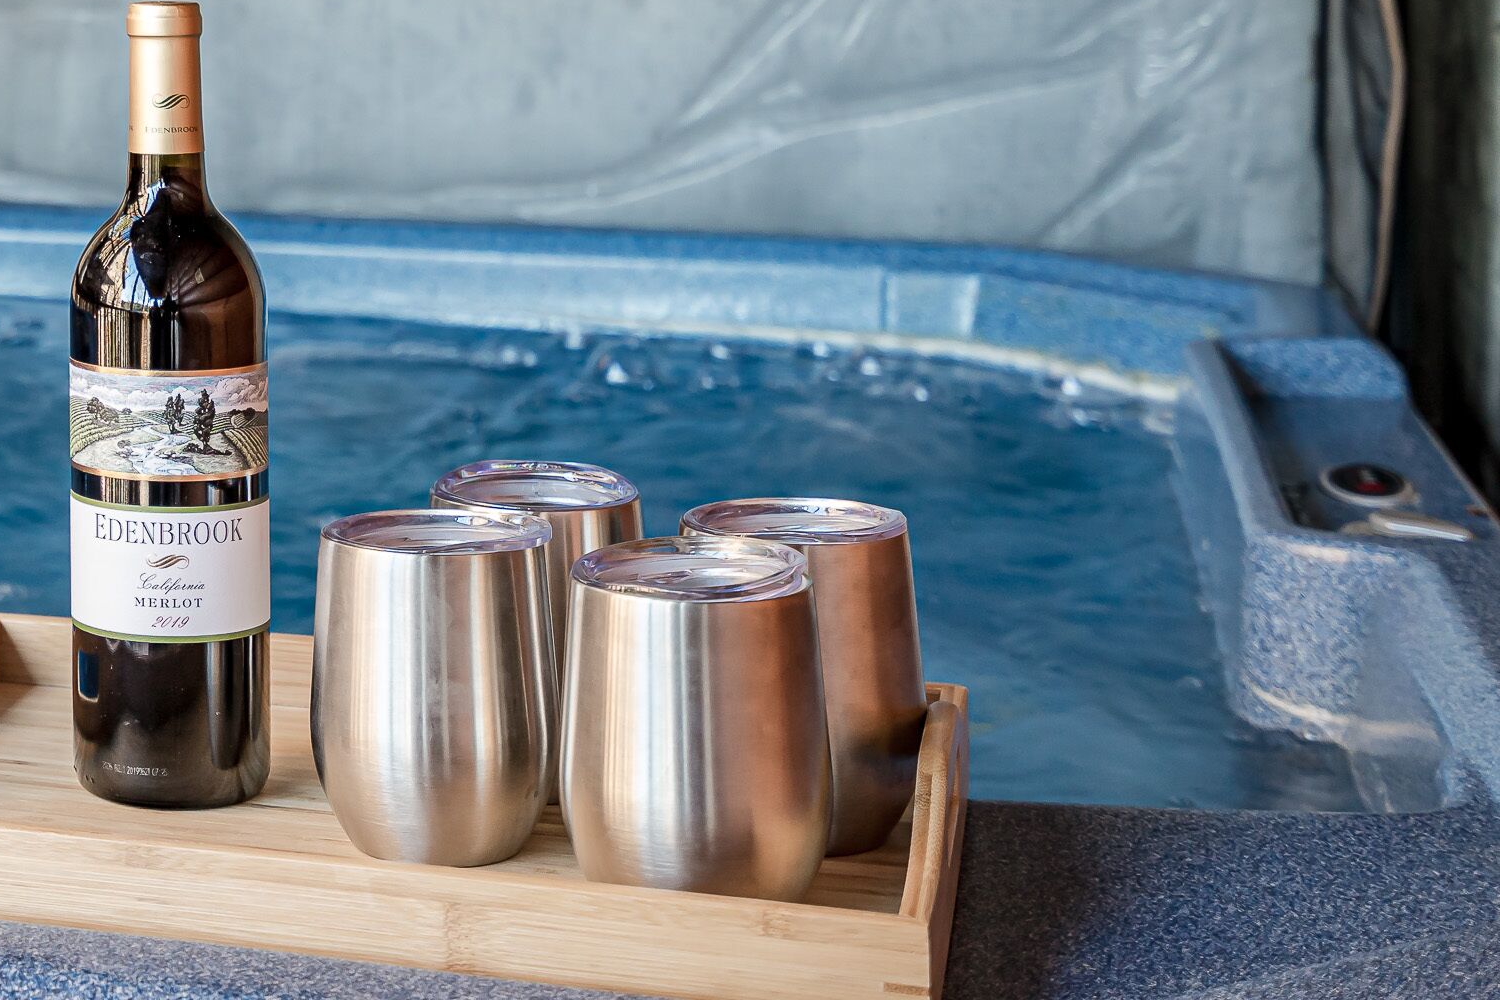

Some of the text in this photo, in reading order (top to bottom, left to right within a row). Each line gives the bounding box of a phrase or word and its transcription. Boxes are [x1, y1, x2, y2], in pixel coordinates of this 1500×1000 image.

[94, 513, 243, 545] EDENBROOK
[138, 572, 206, 595] California
[134, 597, 203, 609] MERLOT
[151, 615, 190, 629] 2019
